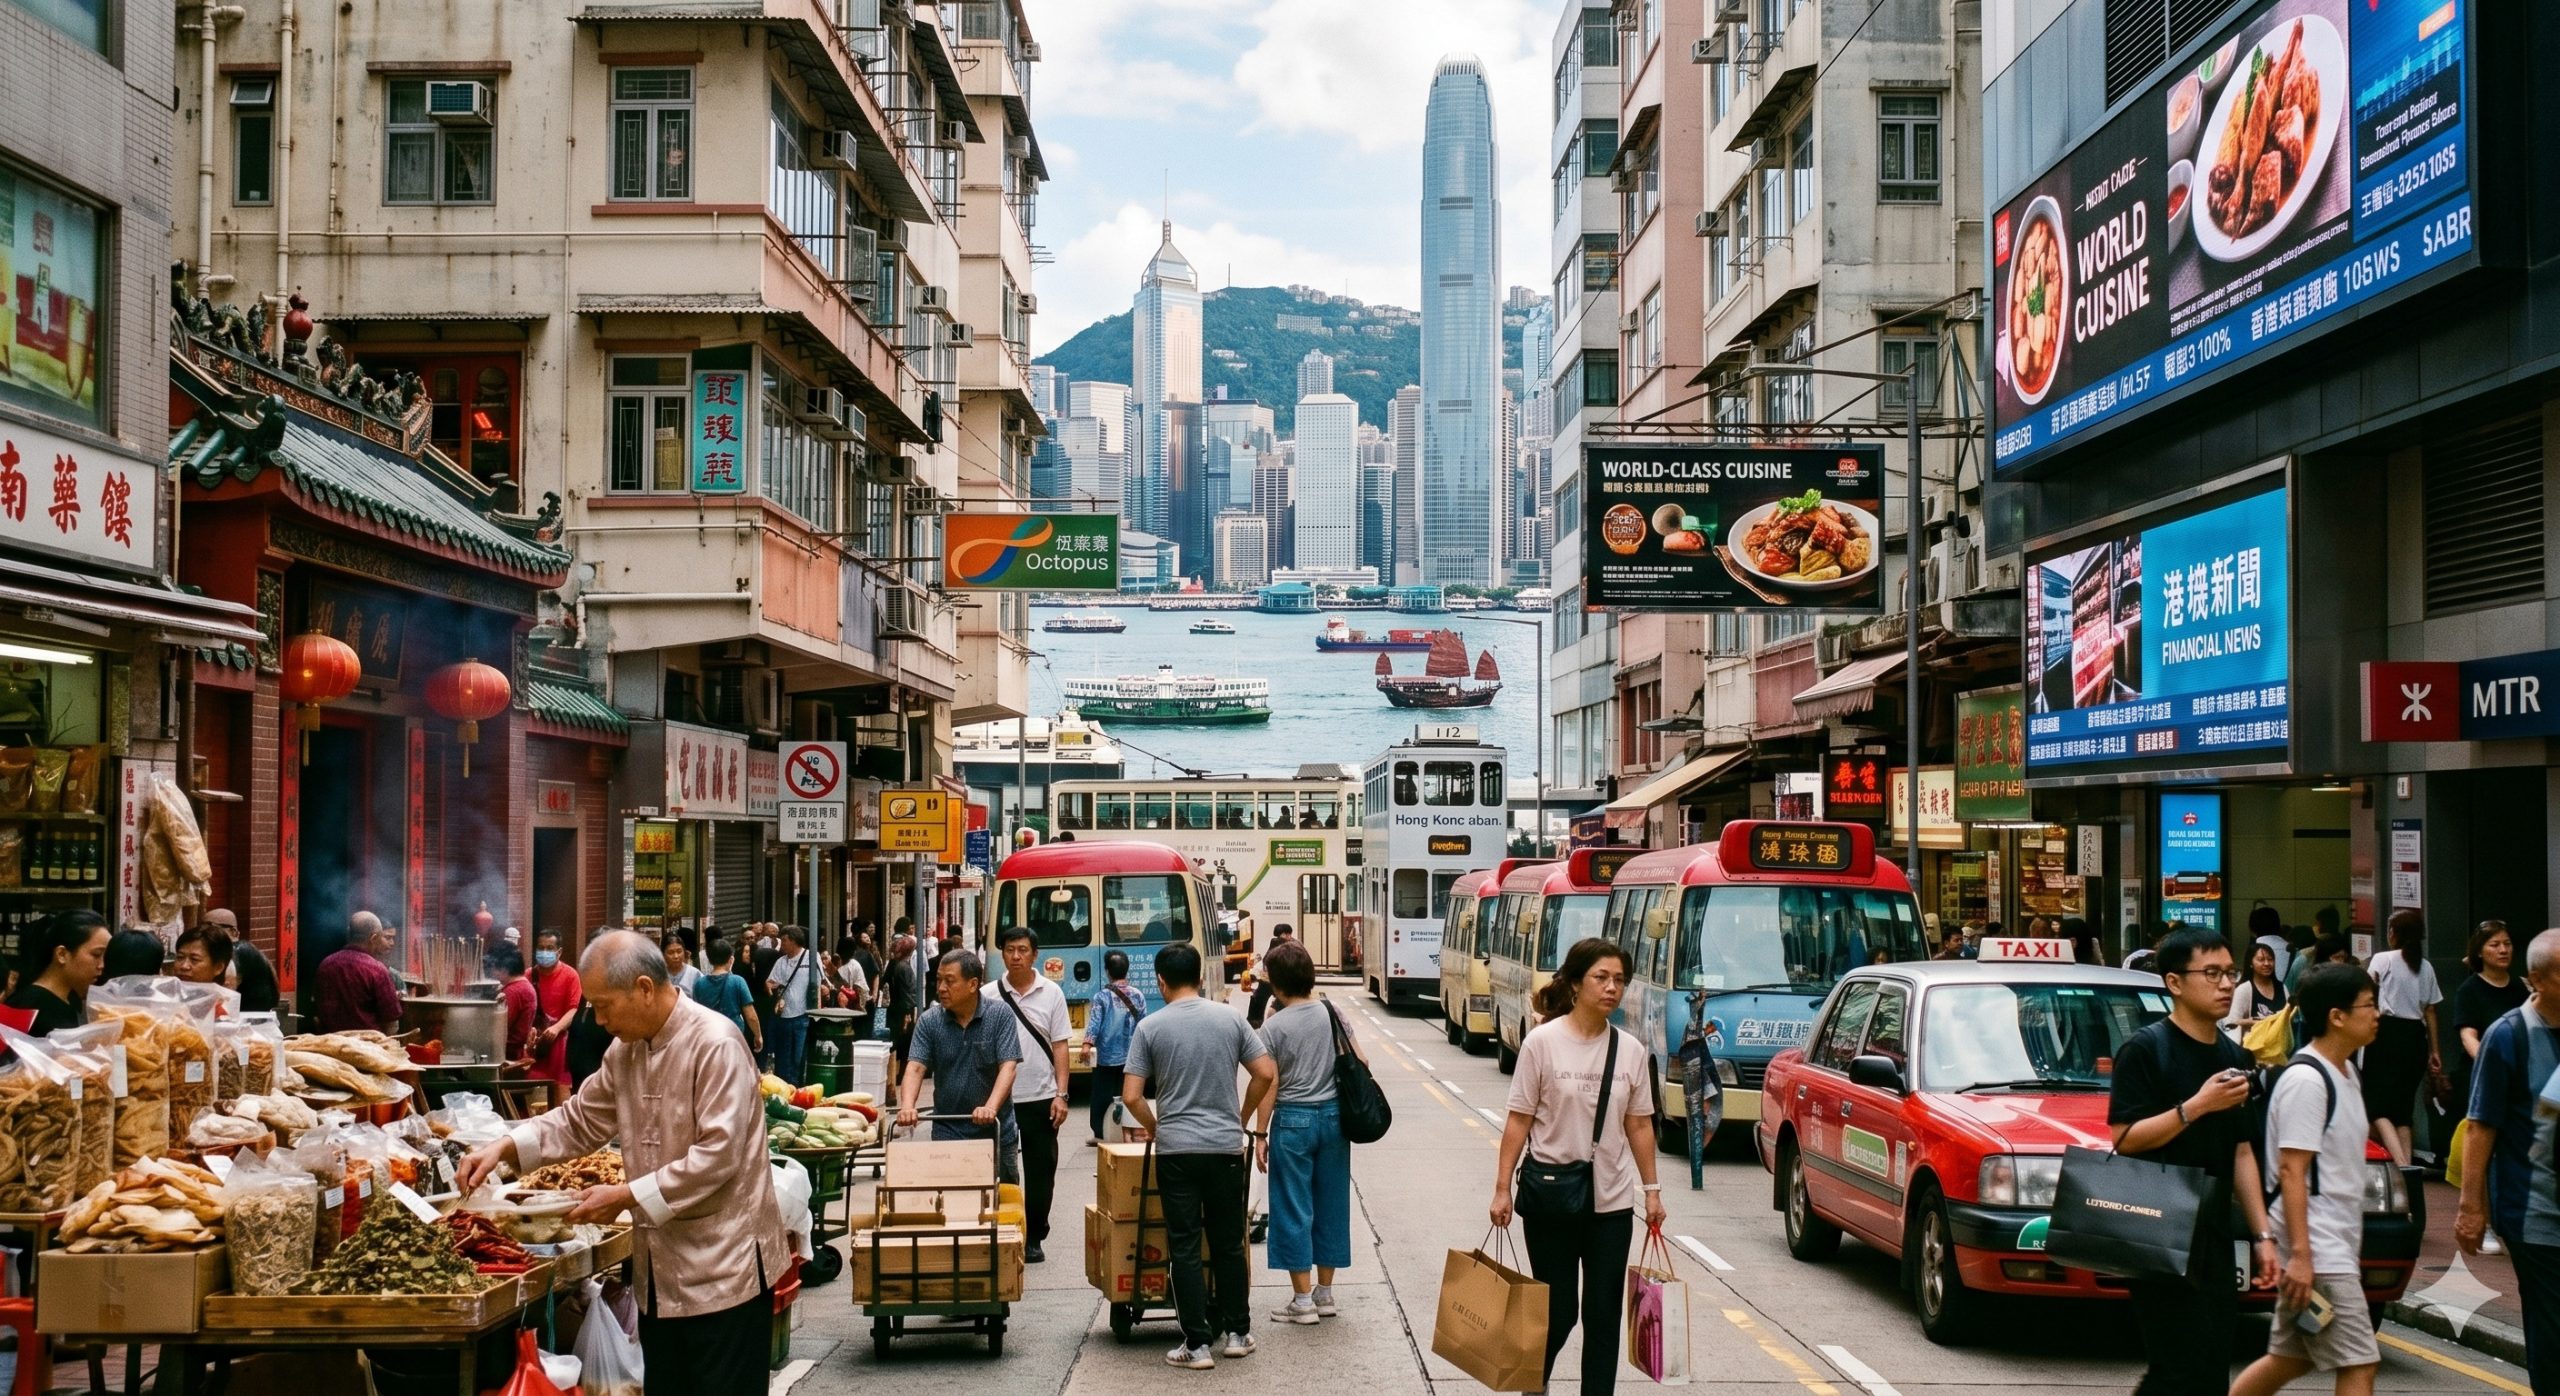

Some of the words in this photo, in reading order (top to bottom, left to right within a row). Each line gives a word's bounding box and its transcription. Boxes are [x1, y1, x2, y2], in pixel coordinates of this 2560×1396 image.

[2077, 200, 2147, 285] WORLD
[2074, 256, 2150, 343] CUISINE
[2197, 325, 2232, 364] 100%
[1602, 461, 1722, 479] WORLD-CLASS
[1725, 462, 1793, 480] CUISINE
[1026, 552, 1109, 573] Octopus
[2162, 632, 2222, 666] FINANCIAL
[2224, 623, 2261, 655] NEWS
[2473, 675, 2541, 718] MTR
[1395, 814, 1428, 828] Hong
[1433, 814, 1465, 826] Konc
[1468, 814, 1502, 827] aban.
[1997, 941, 2060, 958] TAXI
